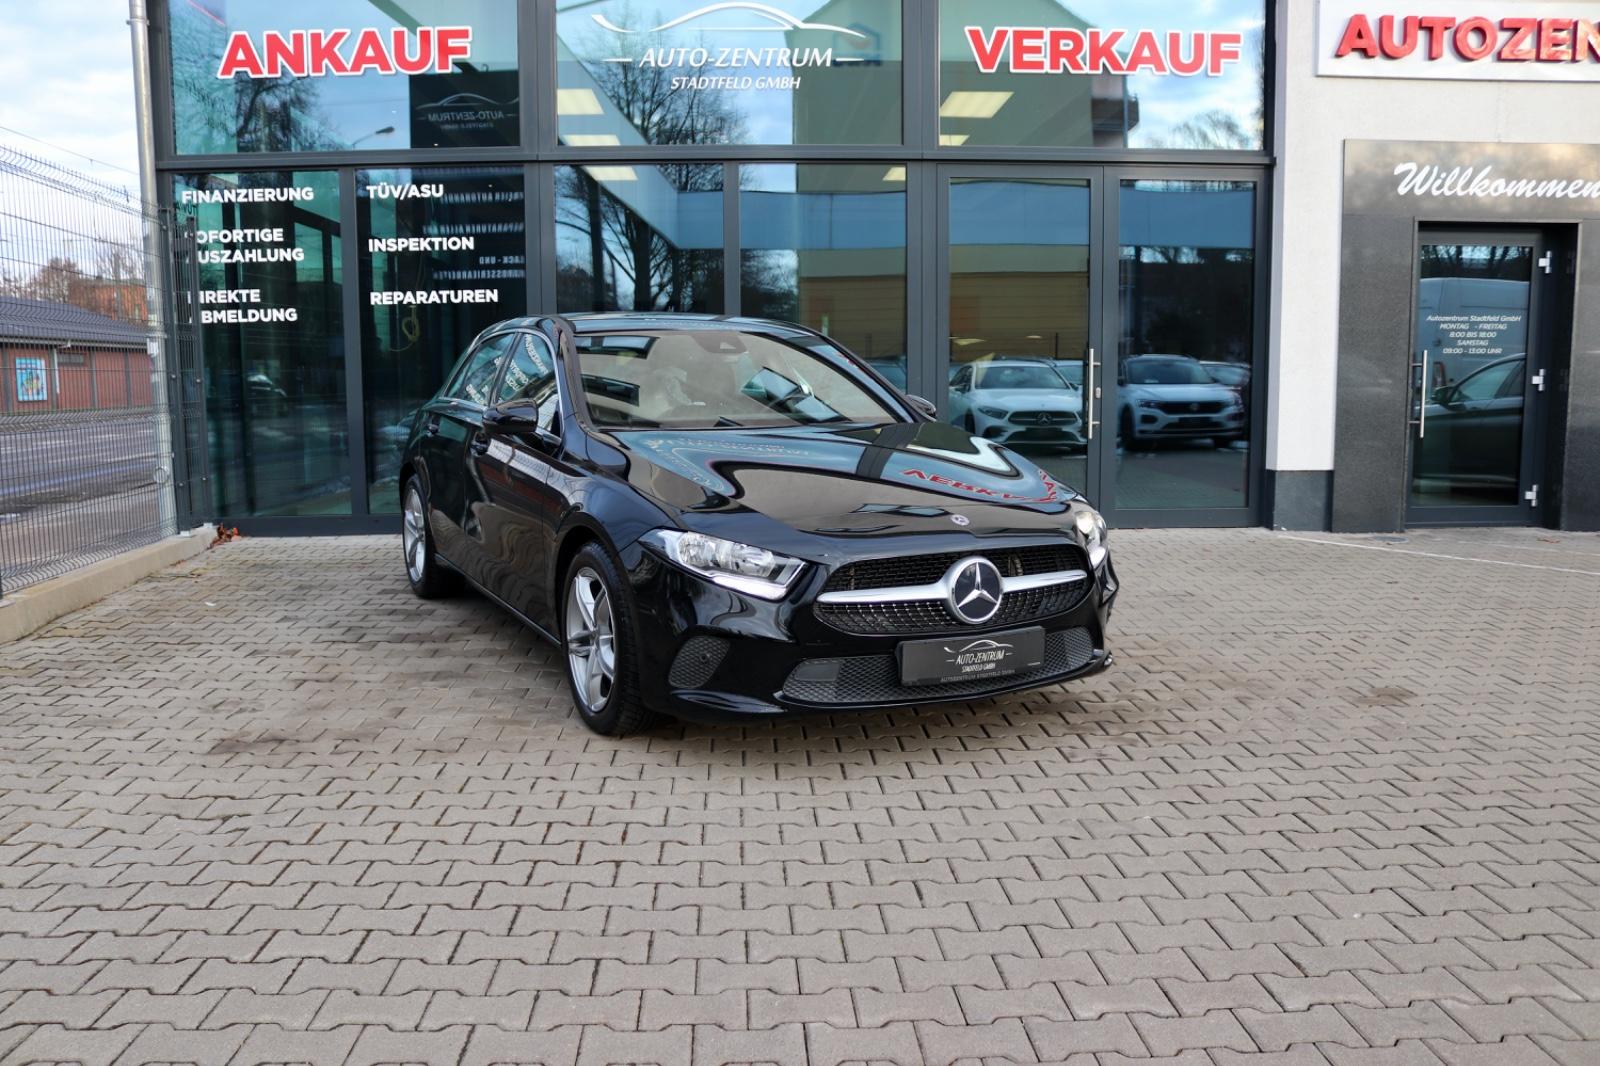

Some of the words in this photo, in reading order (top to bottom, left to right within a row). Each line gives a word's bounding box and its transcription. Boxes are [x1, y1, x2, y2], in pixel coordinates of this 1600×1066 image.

[216, 26, 473, 79] ANKAUF
[639, 47, 833, 68] AUTO-ZENTRUM
[966, 25, 1243, 77] VERKAUF
[670, 76, 752, 90] STADTFELD
[755, 76, 801, 89] GMBH
[1393, 161, 1600, 198] Willkommen
[181, 186, 315, 204] FINANZIERUNG
[366, 182, 445, 200] TÜV/ASU
[367, 236, 475, 253] INSPEKTION
[186, 248, 305, 264] USZAHLUNG
[188, 289, 261, 304] IREKTE
[370, 288, 498, 306] REPARATUREN
[189, 308, 298, 324] BMELDUNG
[956, 650, 1005, 665] AUTO-ZENTRUM
